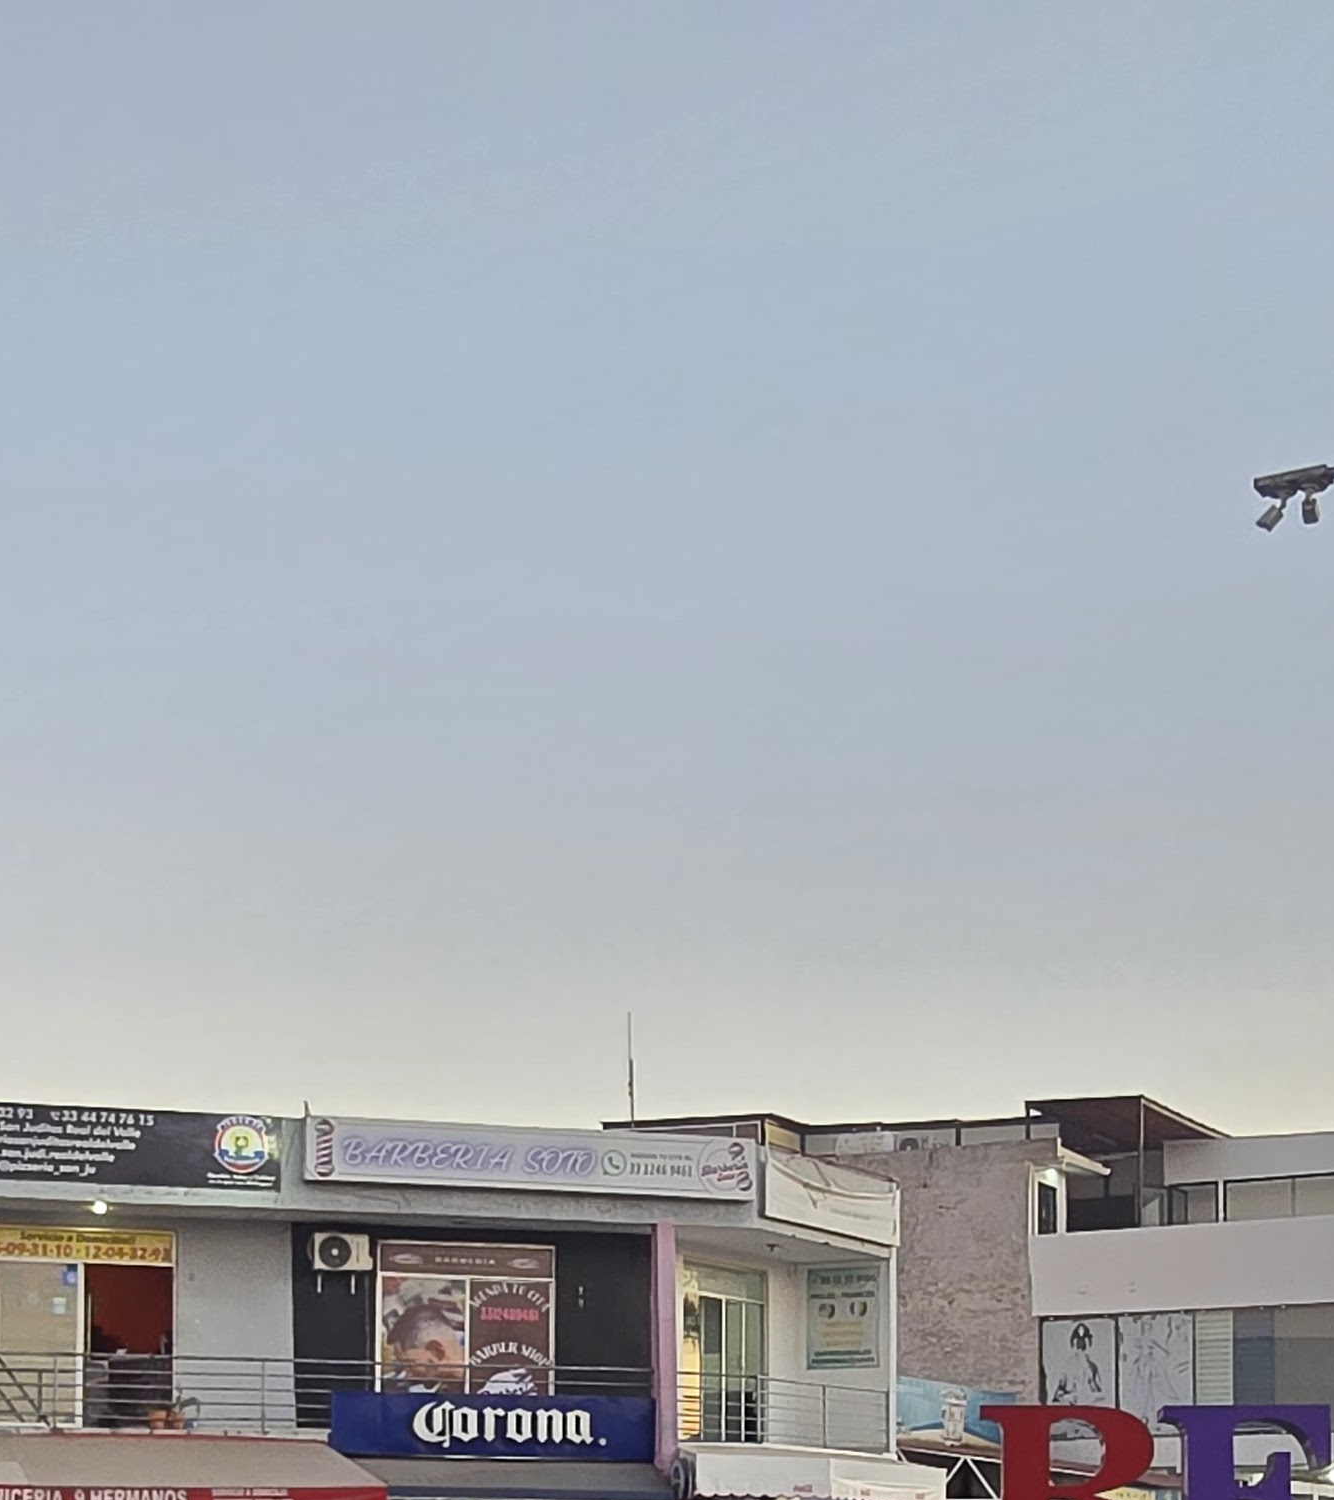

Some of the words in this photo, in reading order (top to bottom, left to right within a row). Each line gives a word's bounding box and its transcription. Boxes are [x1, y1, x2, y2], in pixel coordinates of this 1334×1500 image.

[17, 1108, 34, 1119] 93
[61, 1110, 78, 1122] 33
[80, 1111, 97, 1123] 44
[99, 1112, 116, 1124] 74
[139, 1114, 155, 1126] 15
[0, 1121, 20, 1132] San
[66, 1124, 91, 1135] Real
[93, 1126, 111, 1136] del
[113, 1127, 141, 1139] Valle
[343, 1138, 514, 1171] BARBERIA
[522, 1147, 596, 1177] SOTO
[20, 1231, 64, 1242] Servicio
[412, 1400, 594, 1448] Corona
